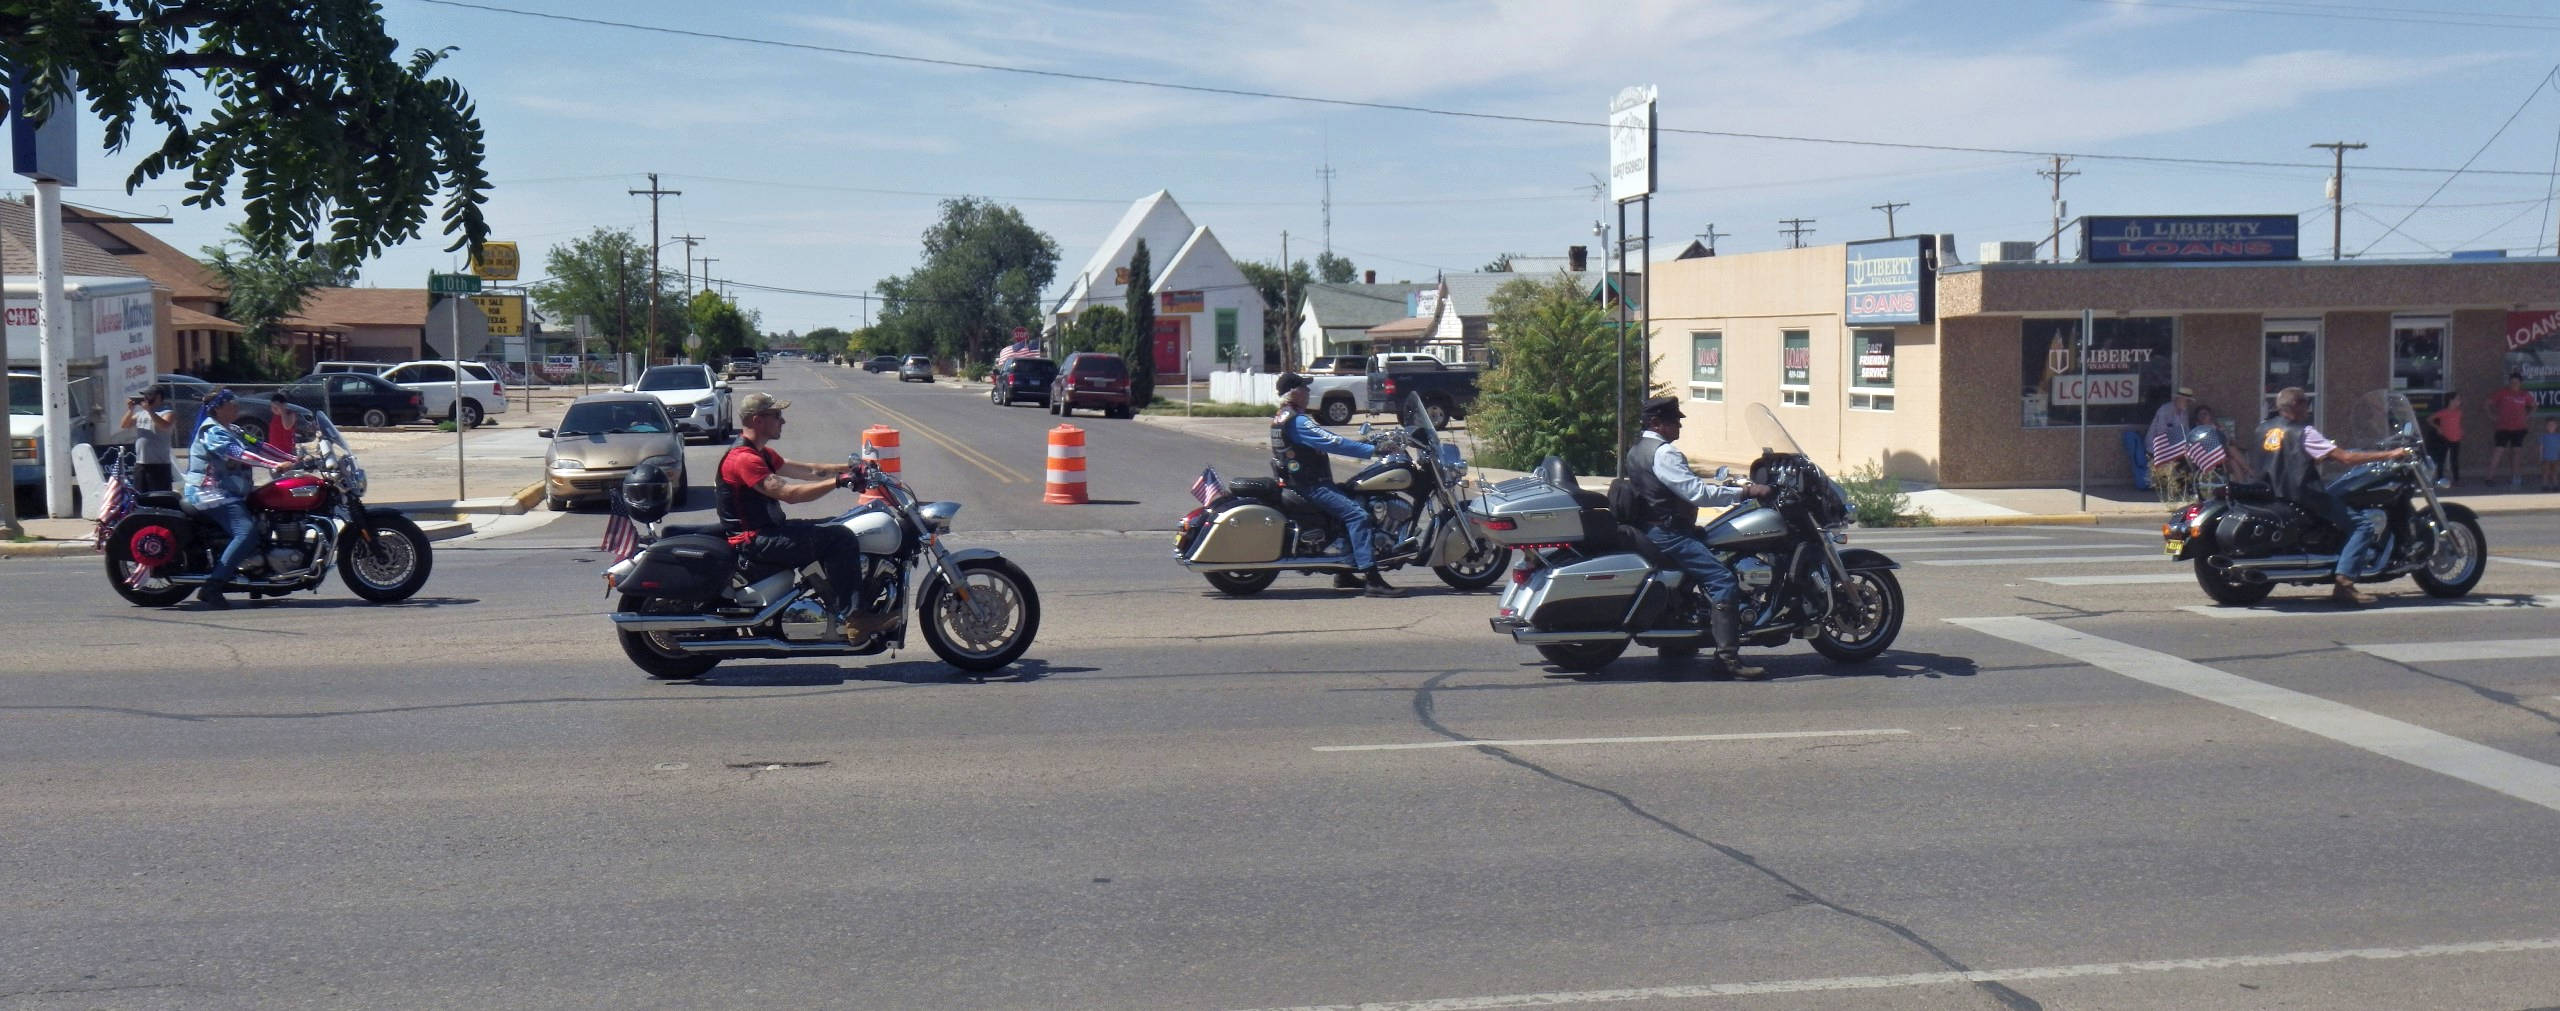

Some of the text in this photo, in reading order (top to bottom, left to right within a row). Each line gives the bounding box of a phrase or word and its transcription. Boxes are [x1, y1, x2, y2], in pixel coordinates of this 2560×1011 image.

[2153, 222, 2261, 236] LIBERTY
[2118, 241, 2273, 257] LOANS
[1866, 257, 1913, 276] LIBERTY
[442, 277, 468, 292] 10th
[1850, 293, 1916, 314] LOANS
[1866, 343, 1883, 354] FAST
[1859, 354, 1890, 366] FRIENDLY
[1861, 367, 1888, 379] SERVICE
[2060, 380, 2134, 400] LOANS
